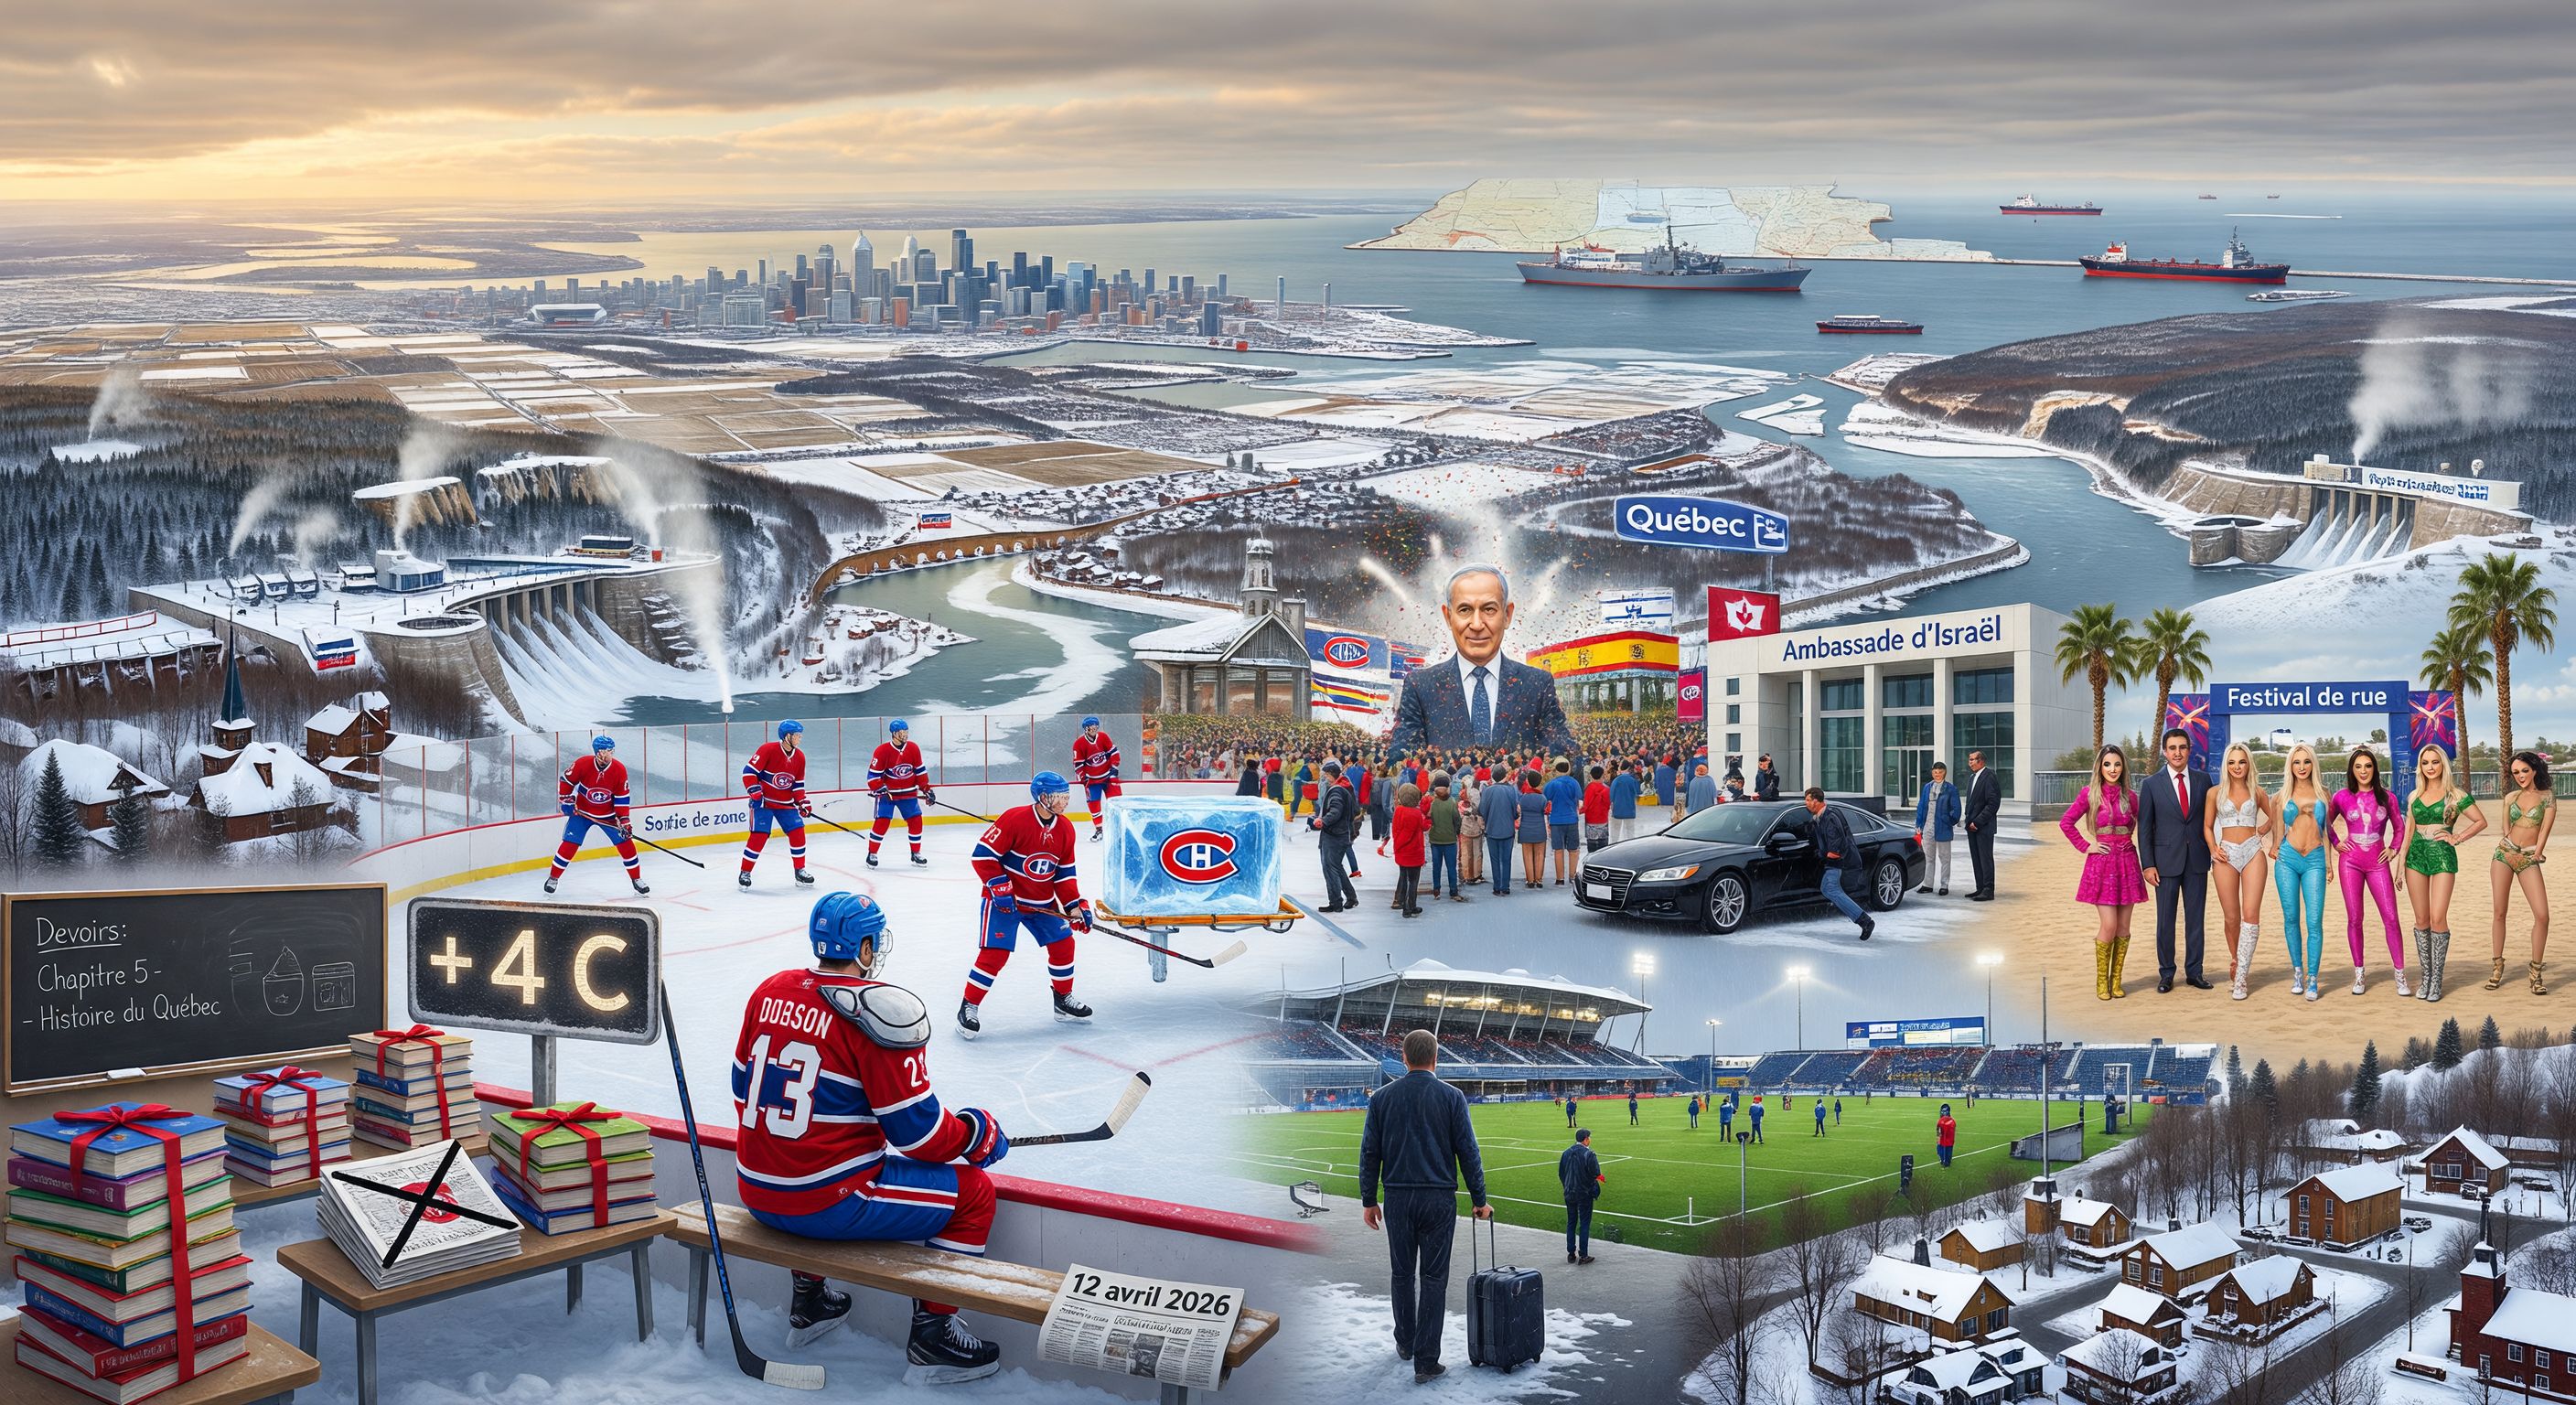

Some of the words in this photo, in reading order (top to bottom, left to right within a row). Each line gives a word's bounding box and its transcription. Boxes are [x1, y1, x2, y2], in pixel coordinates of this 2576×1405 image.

[1626, 504, 1746, 538] Québec
[1782, 627, 1905, 662] Ambassade
[1911, 614, 2002, 649] d'Israël
[2227, 685, 2311, 707] Festival
[2317, 686, 2345, 707] de
[2351, 691, 2388, 706] rue
[692, 810, 710, 828] de
[714, 811, 747, 825] zone
[36, 917, 127, 947] Devoirs:
[38, 962, 126, 1001] Chapitre
[134, 959, 149, 984] 5
[574, 934, 630, 1012] C
[40, 1003, 116, 1031] Histoire
[123, 997, 145, 1023] du
[153, 992, 221, 1021] Québec
[758, 996, 833, 1040] DOBSON
[741, 1034, 822, 1140] 13
[1072, 1272, 1101, 1297] 12
[1104, 1285, 1163, 1308] avril
[1164, 1288, 1231, 1316] 2026
